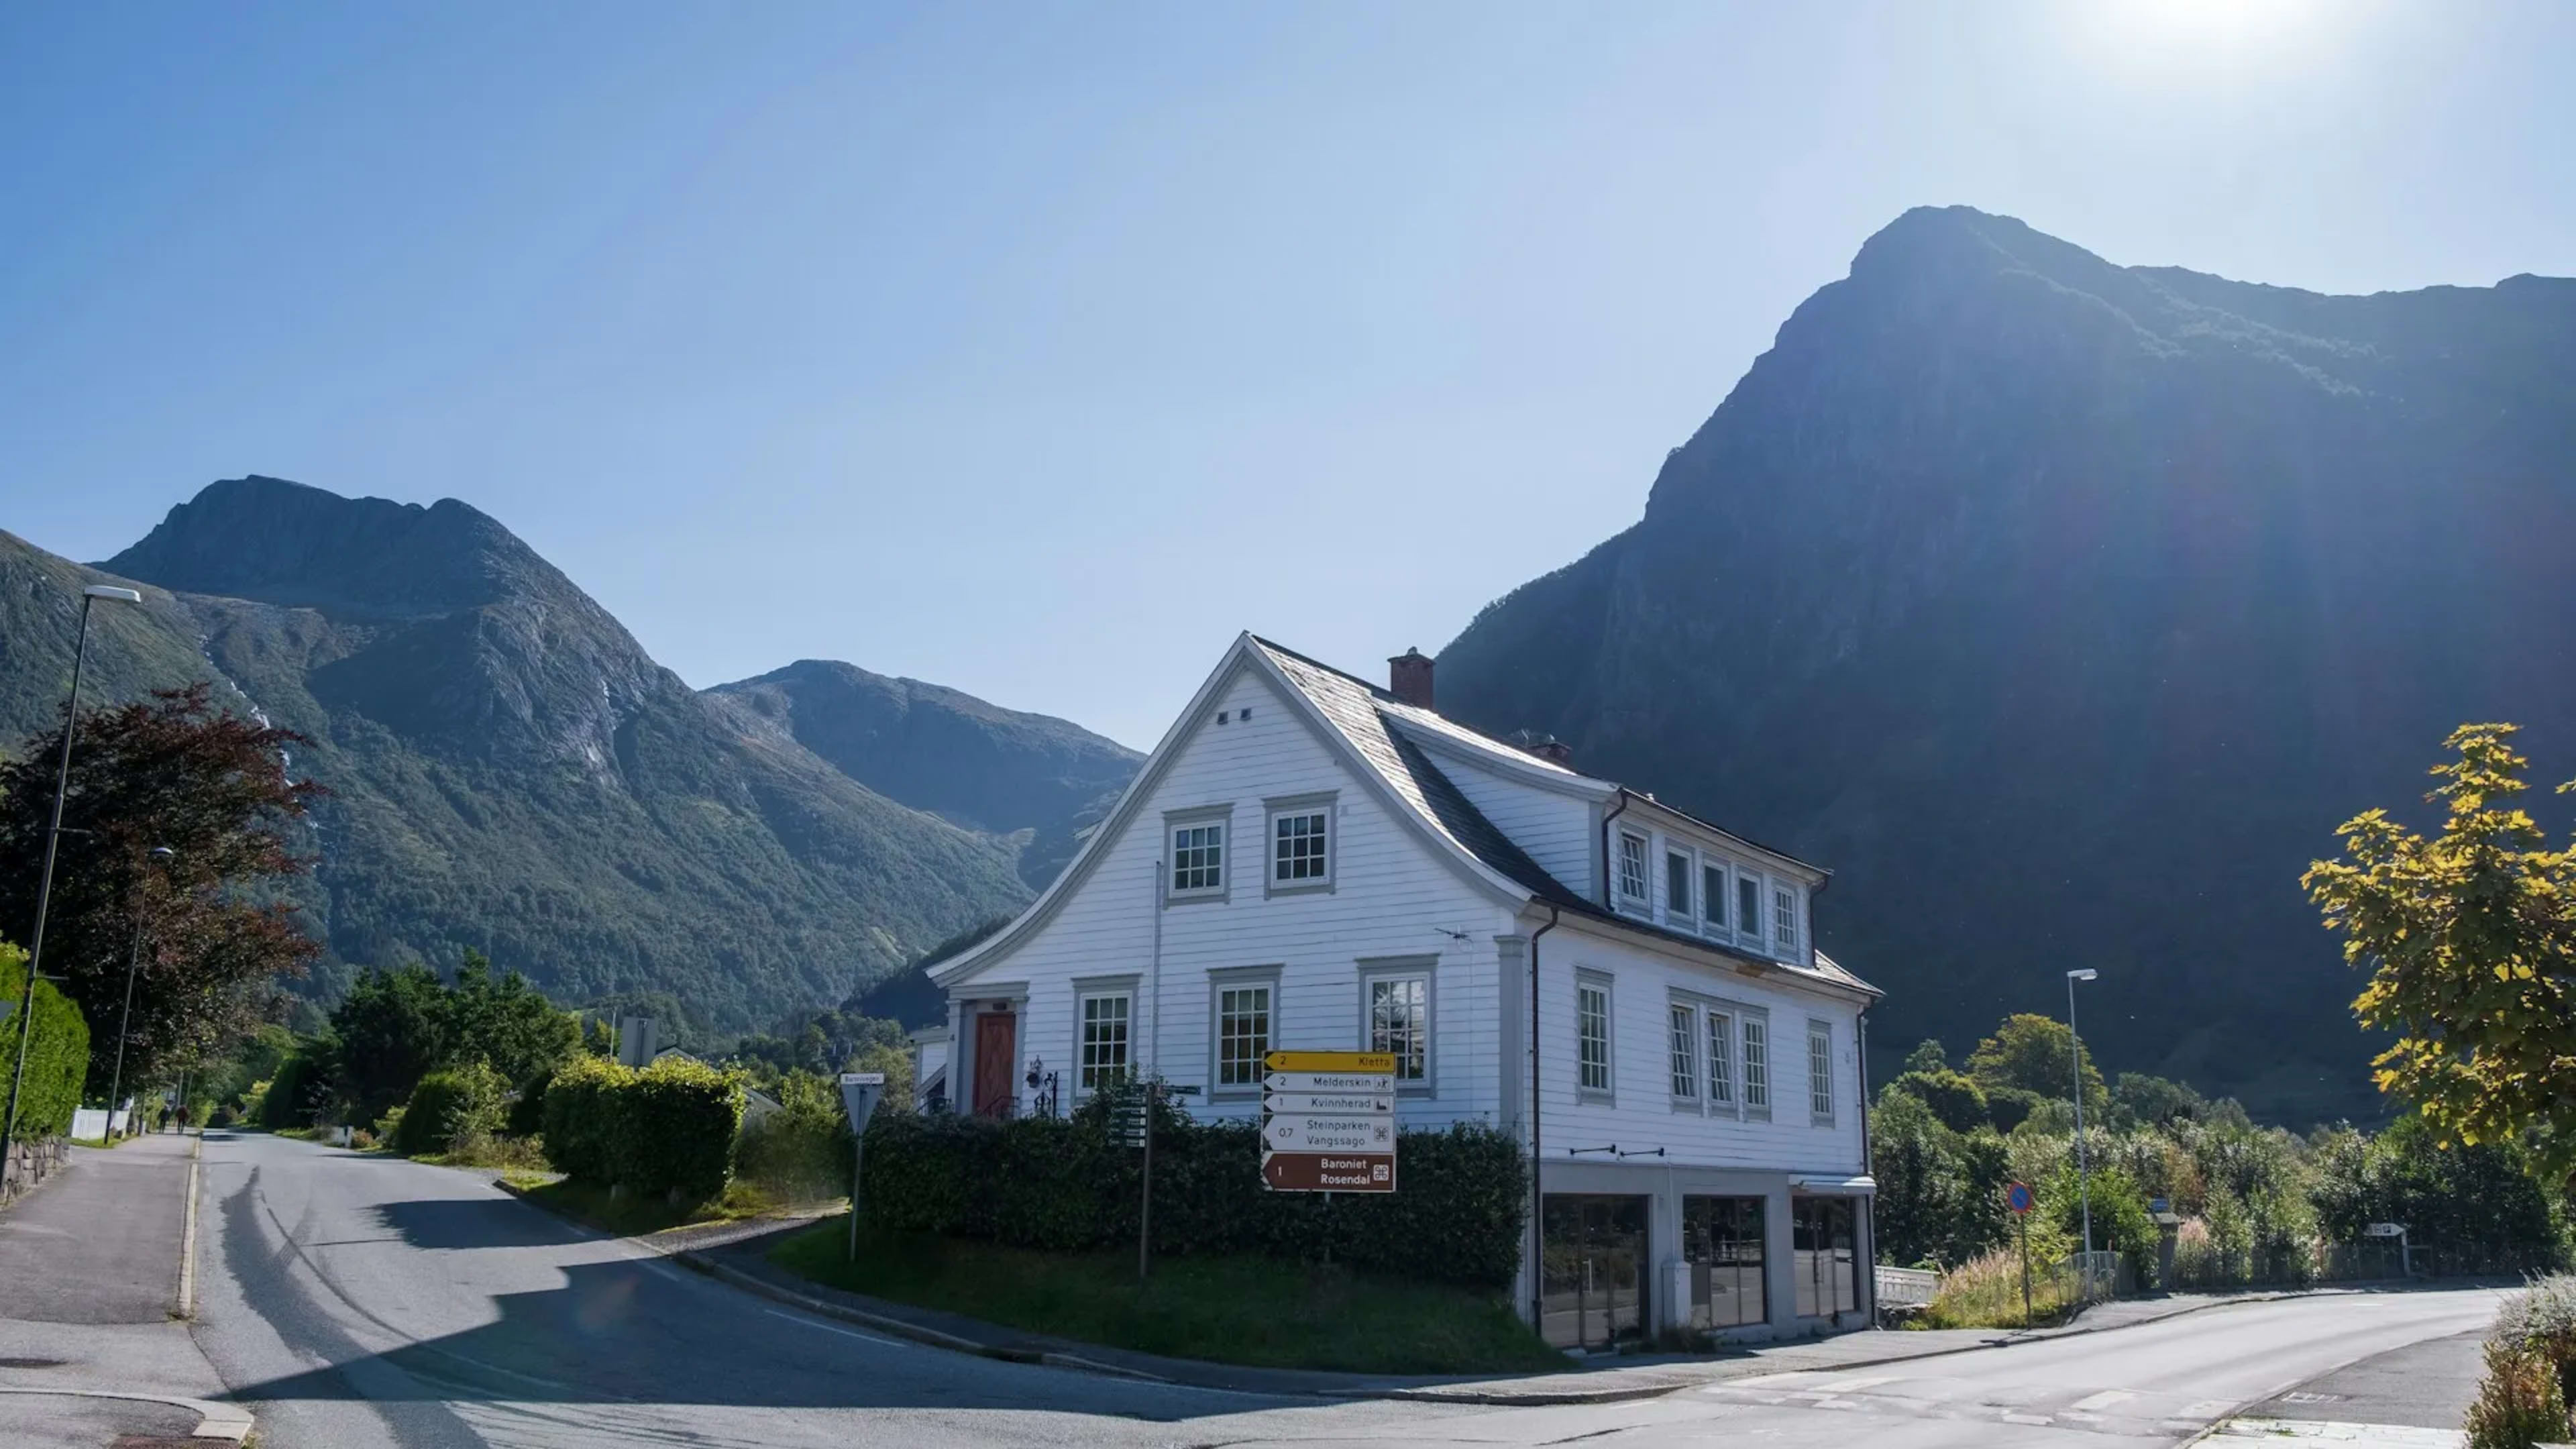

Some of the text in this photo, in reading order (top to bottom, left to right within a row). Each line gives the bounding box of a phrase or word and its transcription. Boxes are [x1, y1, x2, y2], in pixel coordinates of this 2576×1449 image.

[1279, 1056, 1287, 1065] 2
[1279, 1077, 1371, 1087] 2 Melderskin
[1279, 1098, 1371, 1108] 1 Kvinnherad
[1307, 1120, 1371, 1131] Steinparken
[1320, 1158, 1367, 1169] Baroniet
[1320, 1173, 1371, 1185] Rosendal
